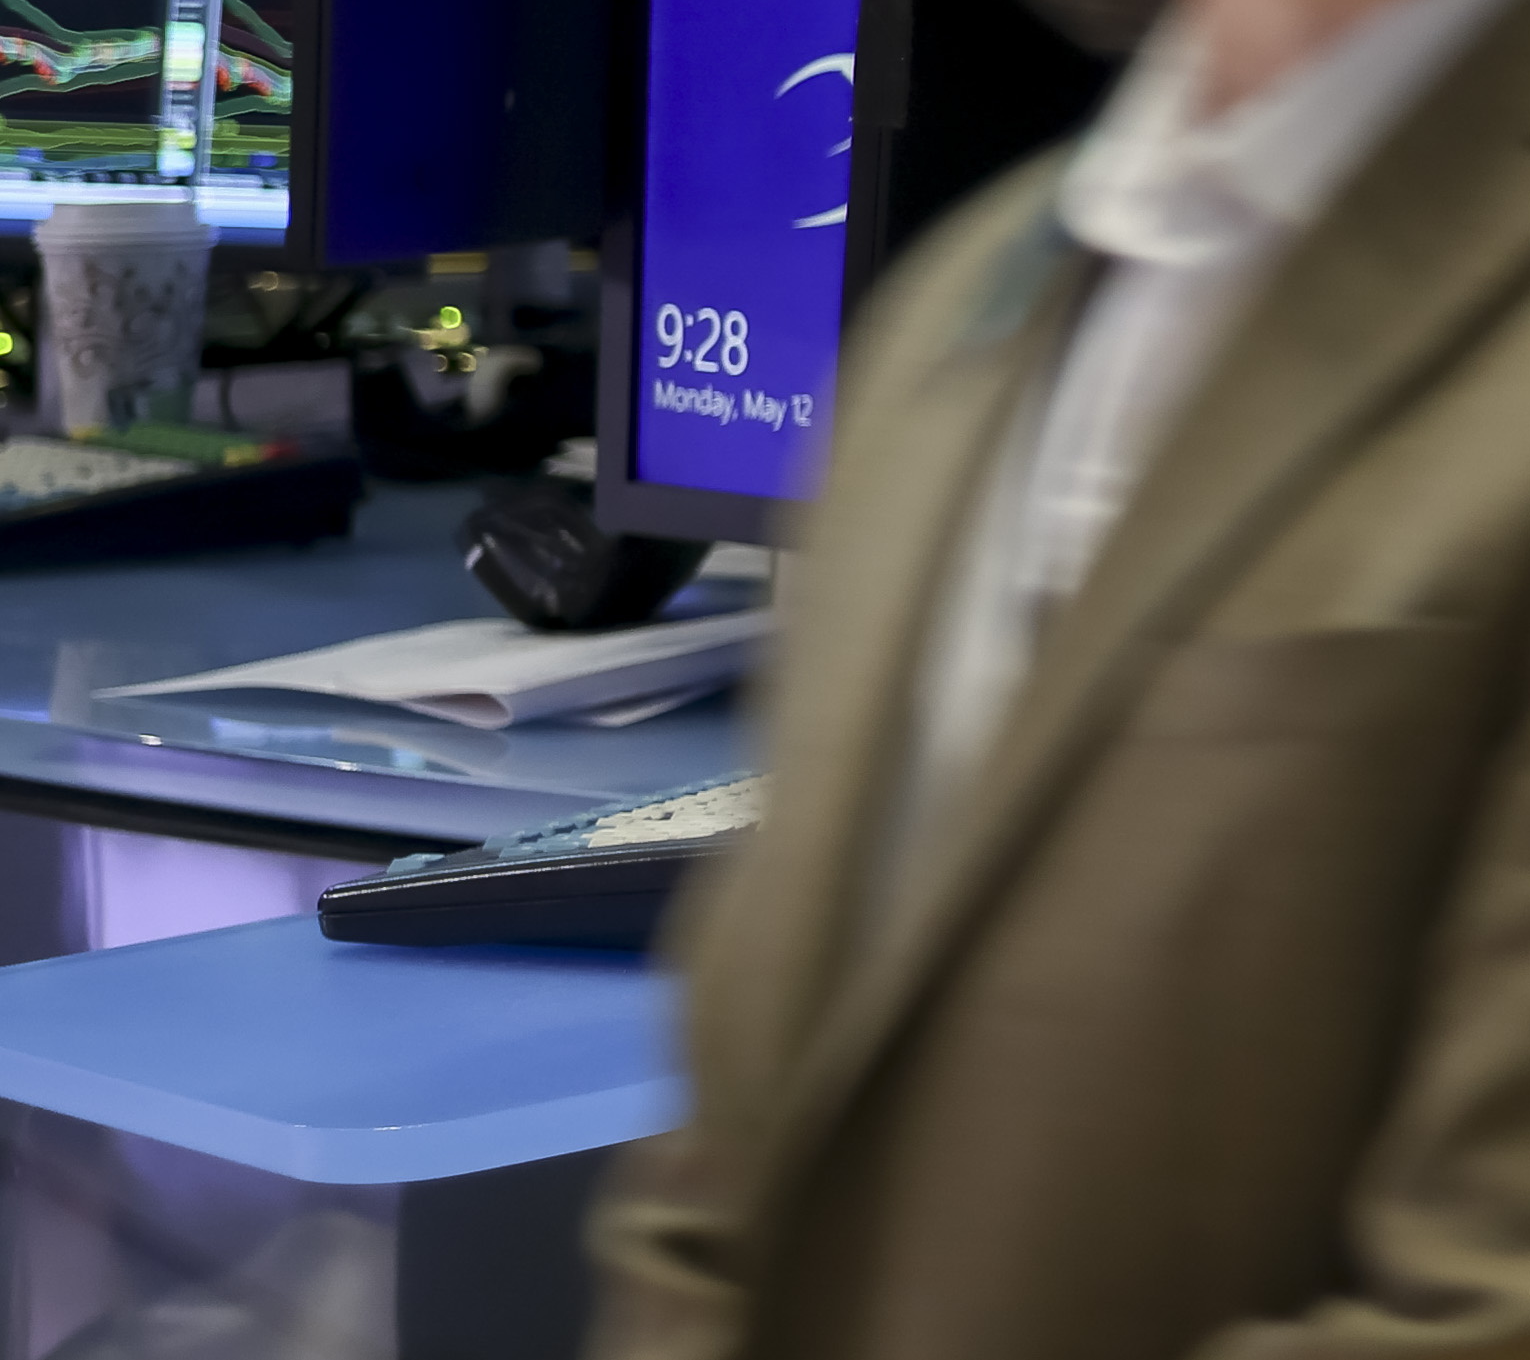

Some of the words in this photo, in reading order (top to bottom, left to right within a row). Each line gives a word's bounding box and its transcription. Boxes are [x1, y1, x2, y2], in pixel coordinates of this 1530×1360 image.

[656, 303, 749, 376] 9:28
[654, 378, 739, 426] Monday,
[743, 388, 787, 432] May
[791, 393, 814, 428] 12
